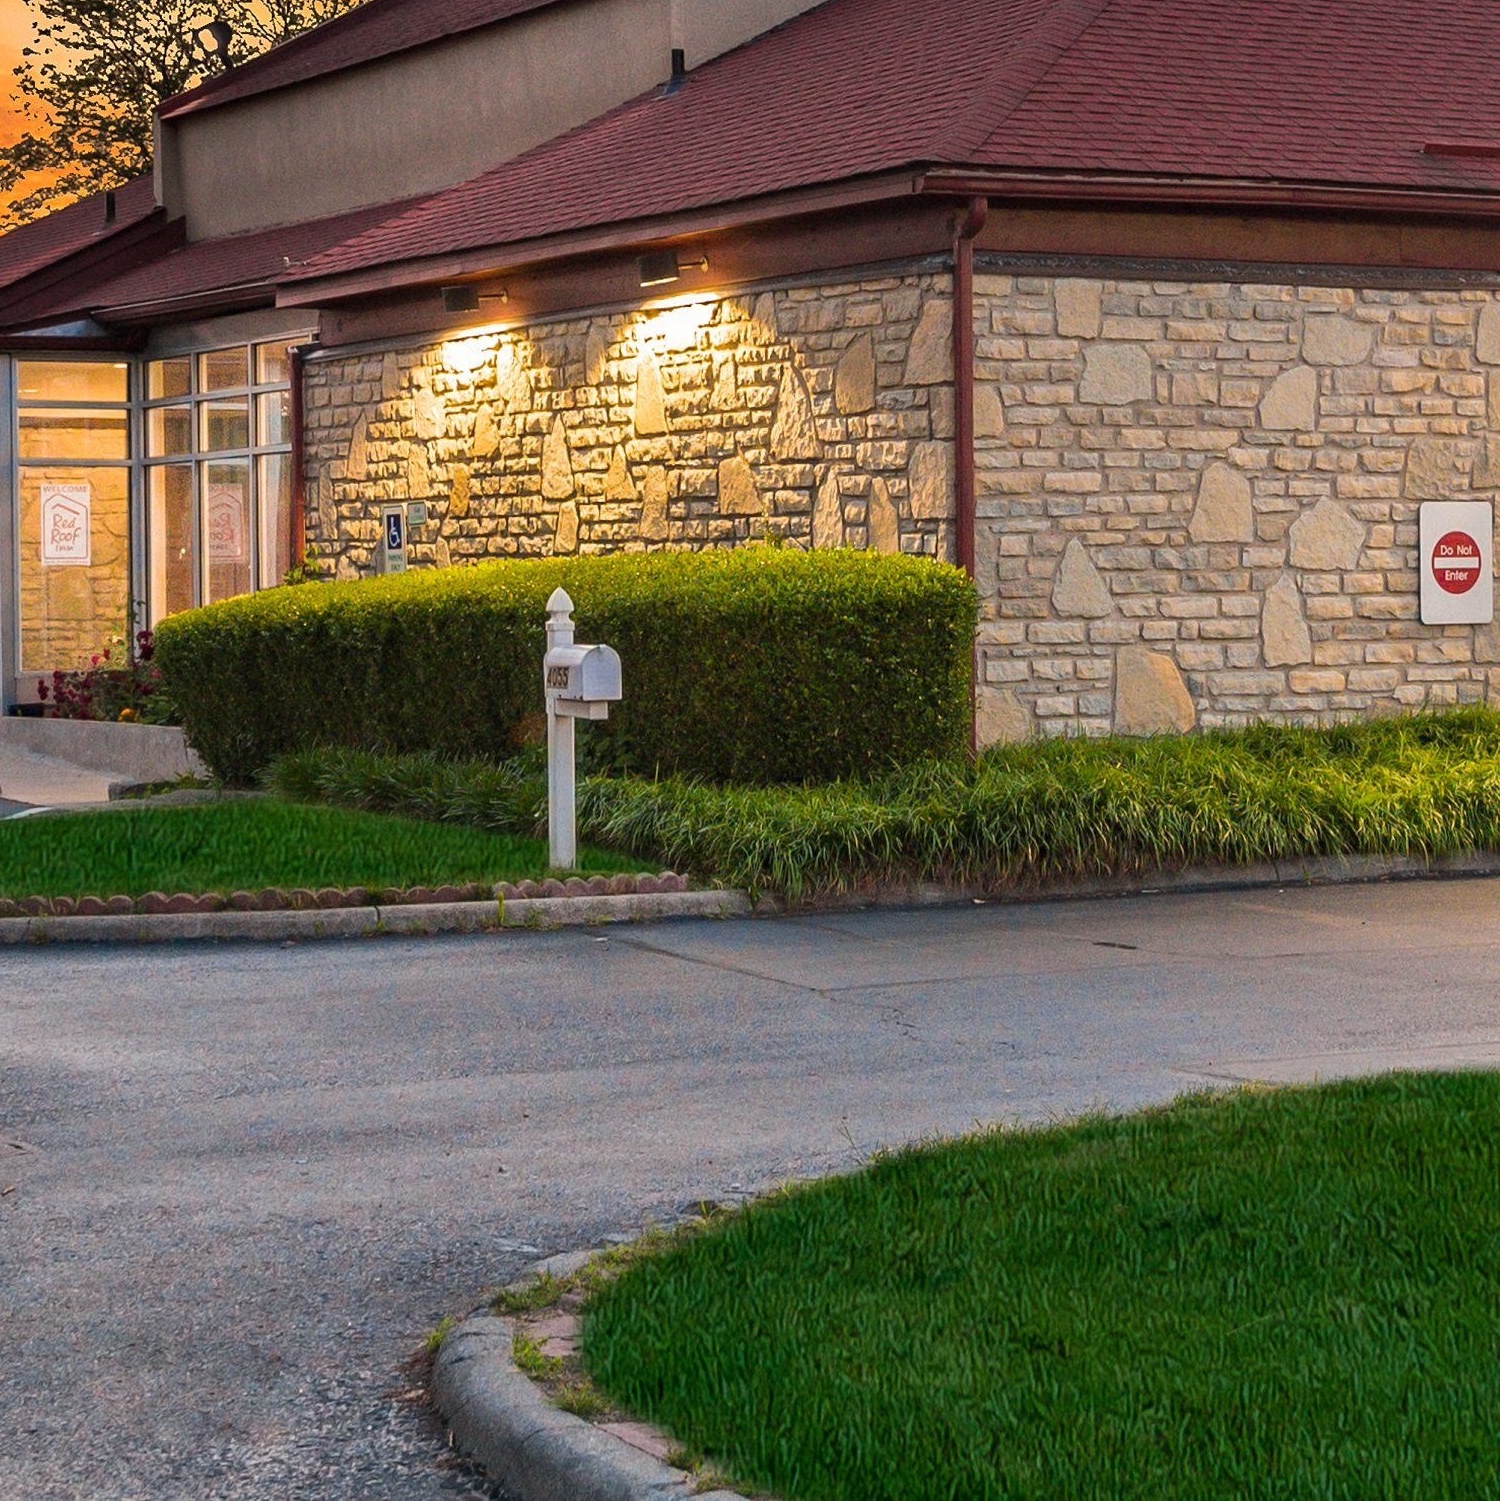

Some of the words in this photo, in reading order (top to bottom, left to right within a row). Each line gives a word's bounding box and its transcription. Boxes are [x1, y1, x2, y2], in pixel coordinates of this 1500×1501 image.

[43, 485, 87, 493] WELCOME
[52, 513, 77, 529] Red
[51, 527, 81, 545] Roof
[1440, 545, 1453, 556] Do
[1456, 545, 1472, 556] Not
[1444, 570, 1468, 581] Enter
